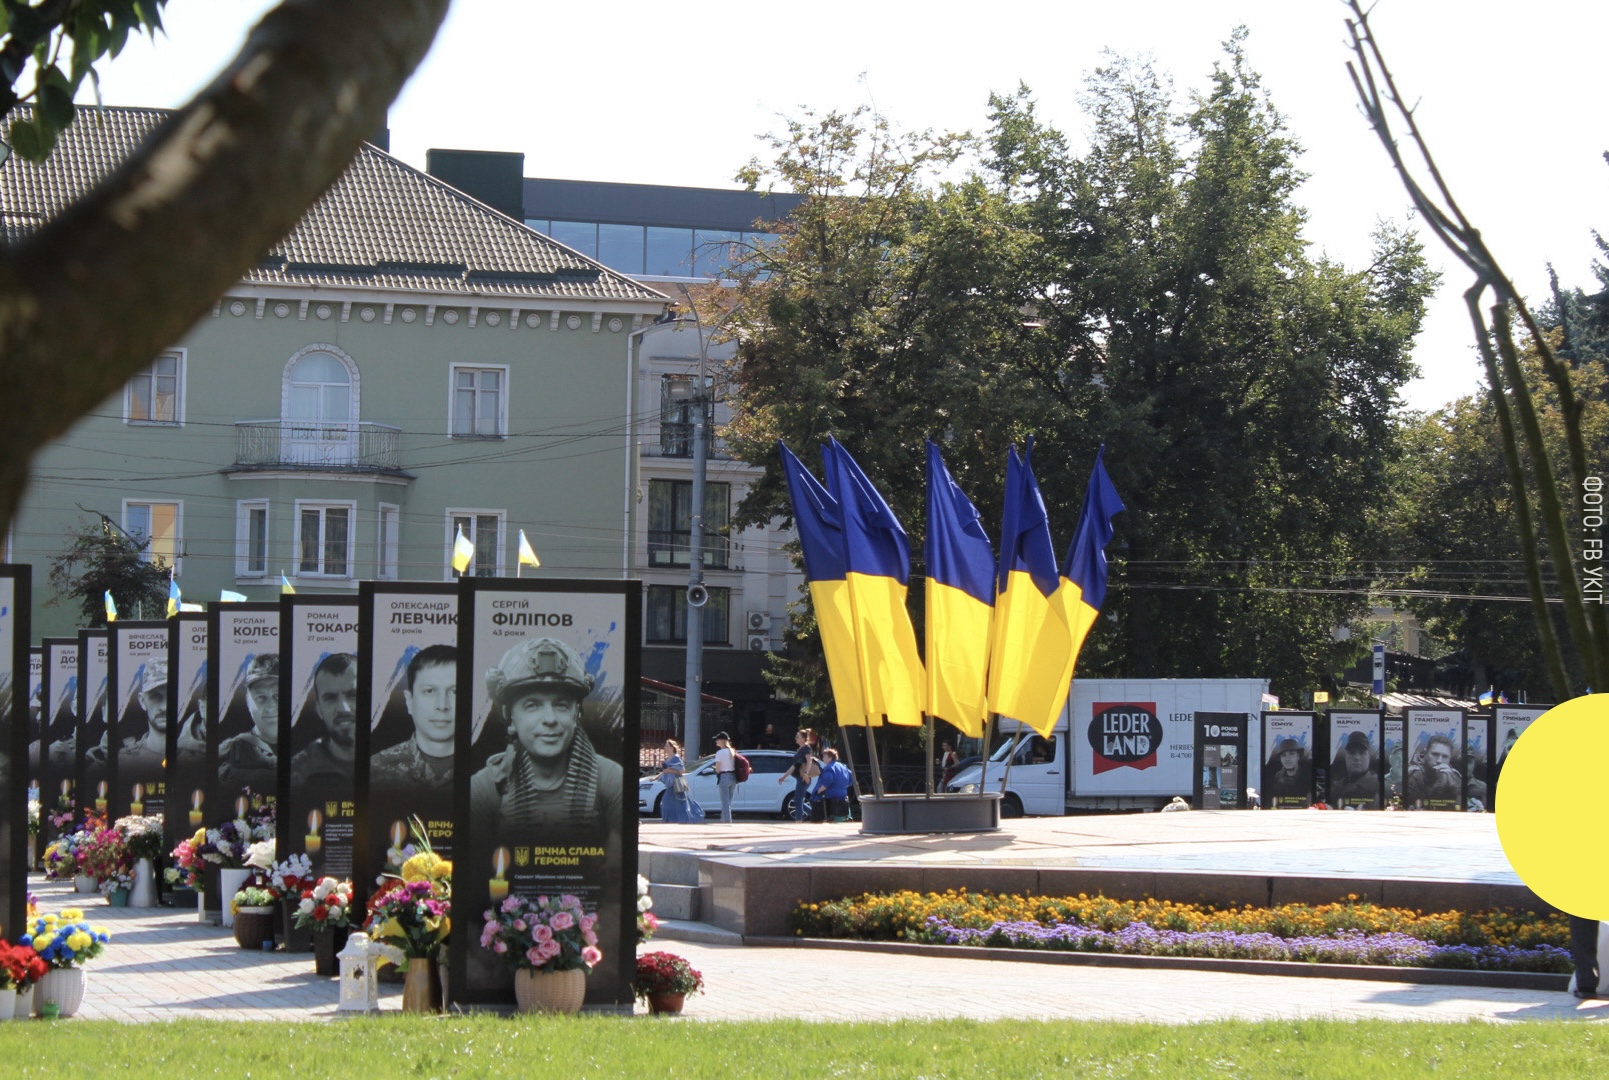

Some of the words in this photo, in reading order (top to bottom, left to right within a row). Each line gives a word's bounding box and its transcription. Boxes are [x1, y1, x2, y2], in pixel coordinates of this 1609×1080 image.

[390, 602, 450, 610] ОЛЕКСАНДР
[492, 600, 529, 609] СЕРГІЙ
[492, 612, 573, 627] ФІЛІПОВ
[233, 626, 278, 636] КОЛЕС
[1169, 713, 1193, 722] LEDE
[1103, 713, 1150, 733] LEDER
[1203, 724, 1220, 738] 10
[1103, 735, 1150, 756] LAND
[534, 847, 566, 856] ВІЧНА
[568, 847, 605, 856] СЛАВА
[534, 857, 579, 866] ГЕРОЯМ!
